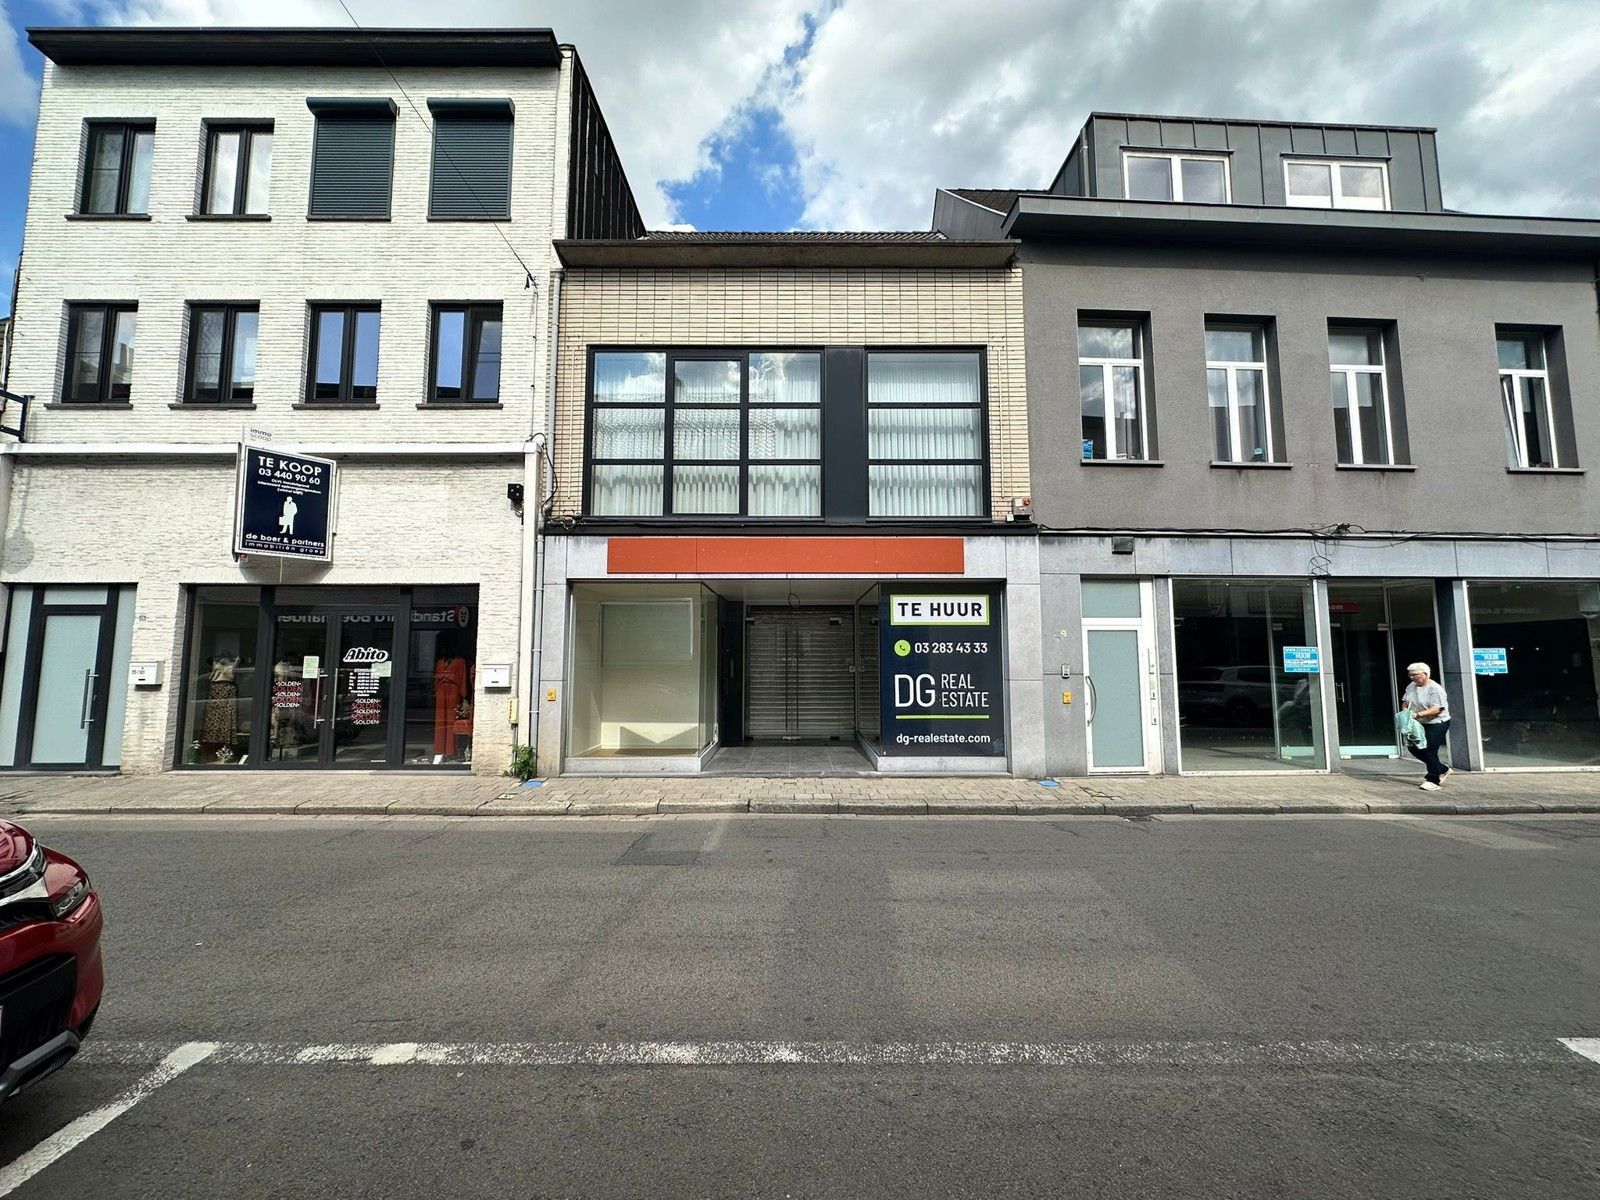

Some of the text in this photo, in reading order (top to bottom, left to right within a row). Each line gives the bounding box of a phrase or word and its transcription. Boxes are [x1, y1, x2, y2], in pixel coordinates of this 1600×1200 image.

[258, 456, 322, 476] TE KOOP
[258, 468, 271, 476] 03
[274, 471, 292, 480] 440
[295, 474, 306, 482] 90
[260, 533, 281, 542] boer
[292, 539, 325, 547] partners
[897, 602, 983, 617] TE HUUR
[343, 647, 388, 663] Abito
[914, 642, 988, 654] 03 283 43 33
[894, 673, 975, 708] DG REAL
[941, 691, 990, 708] ESTATE
[896, 733, 991, 746] dg-realestate.com
